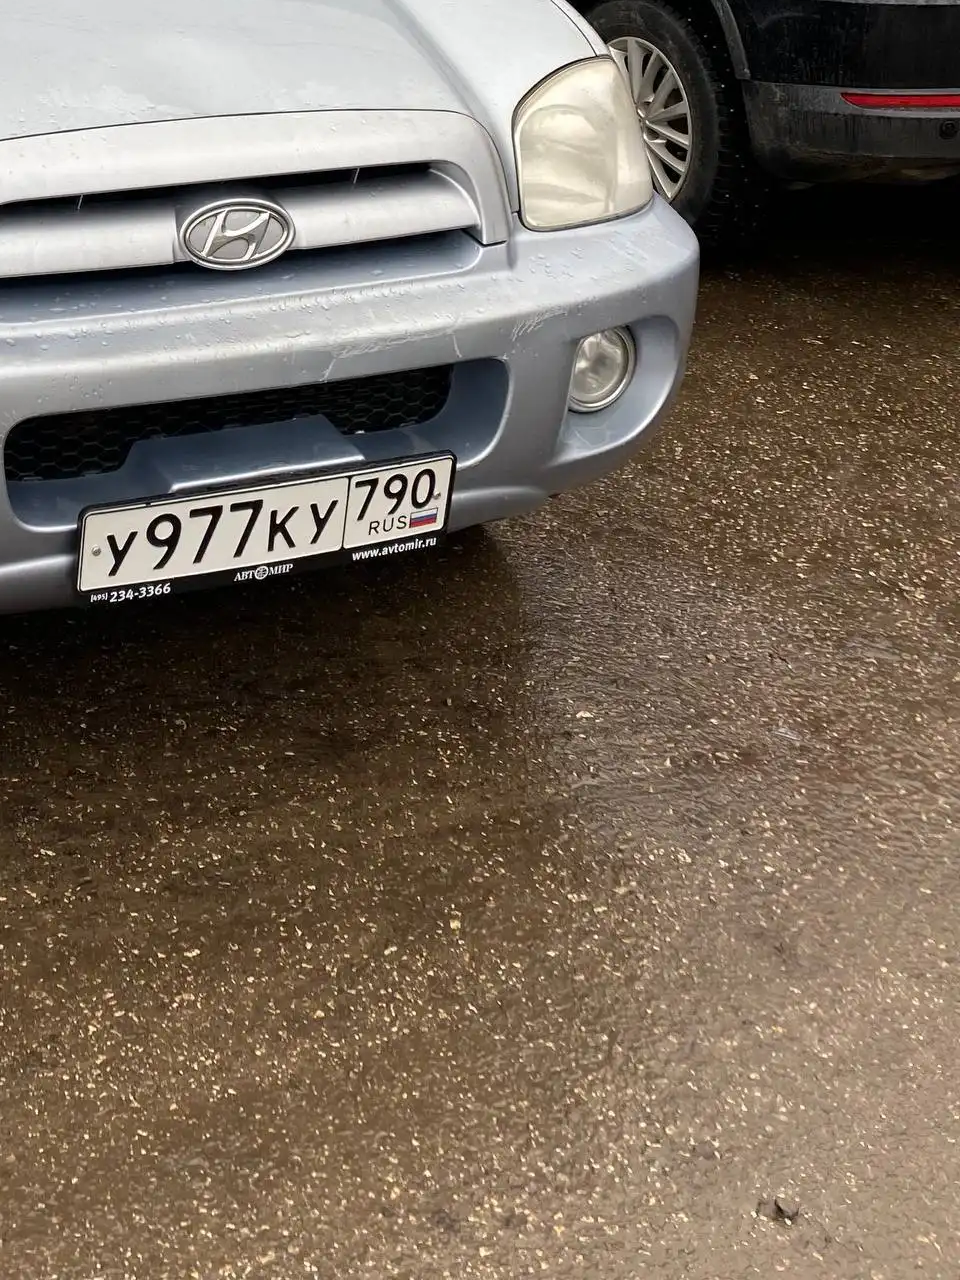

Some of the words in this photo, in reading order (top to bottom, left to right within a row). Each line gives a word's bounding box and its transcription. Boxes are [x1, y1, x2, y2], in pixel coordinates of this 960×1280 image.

[355, 468, 436, 521] 790
[368, 515, 408, 535] RUS
[352, 537, 437, 561] www.avtomir.ru
[109, 582, 171, 603] 234-3366
